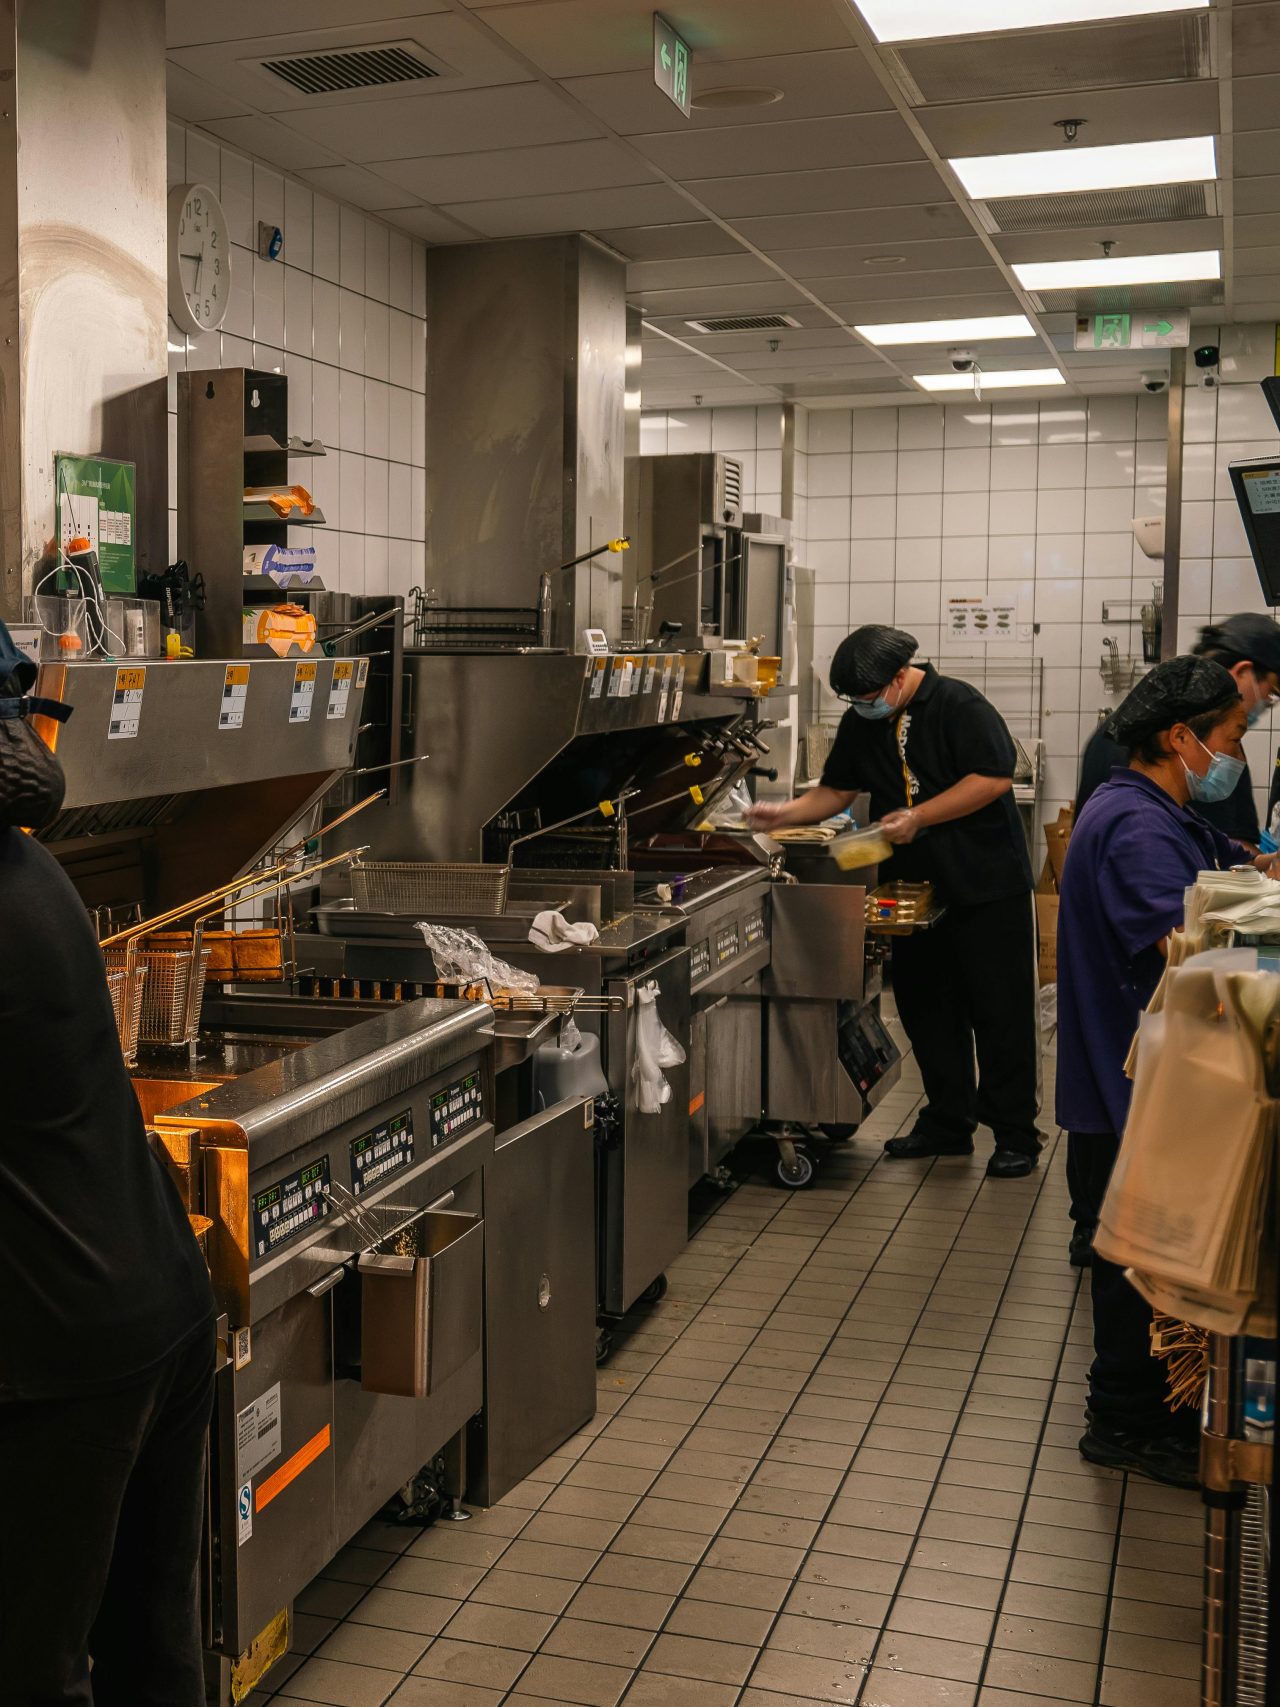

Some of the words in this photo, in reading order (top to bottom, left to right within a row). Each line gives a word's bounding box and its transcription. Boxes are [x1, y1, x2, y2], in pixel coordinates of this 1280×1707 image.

[185, 201, 192, 219] 11
[194, 198, 202, 216] 12
[211, 231, 217, 249] 2
[214, 259, 220, 276] 3
[211, 284, 217, 300] 4
[195, 303, 201, 321] 6
[204, 300, 210, 317] 5
